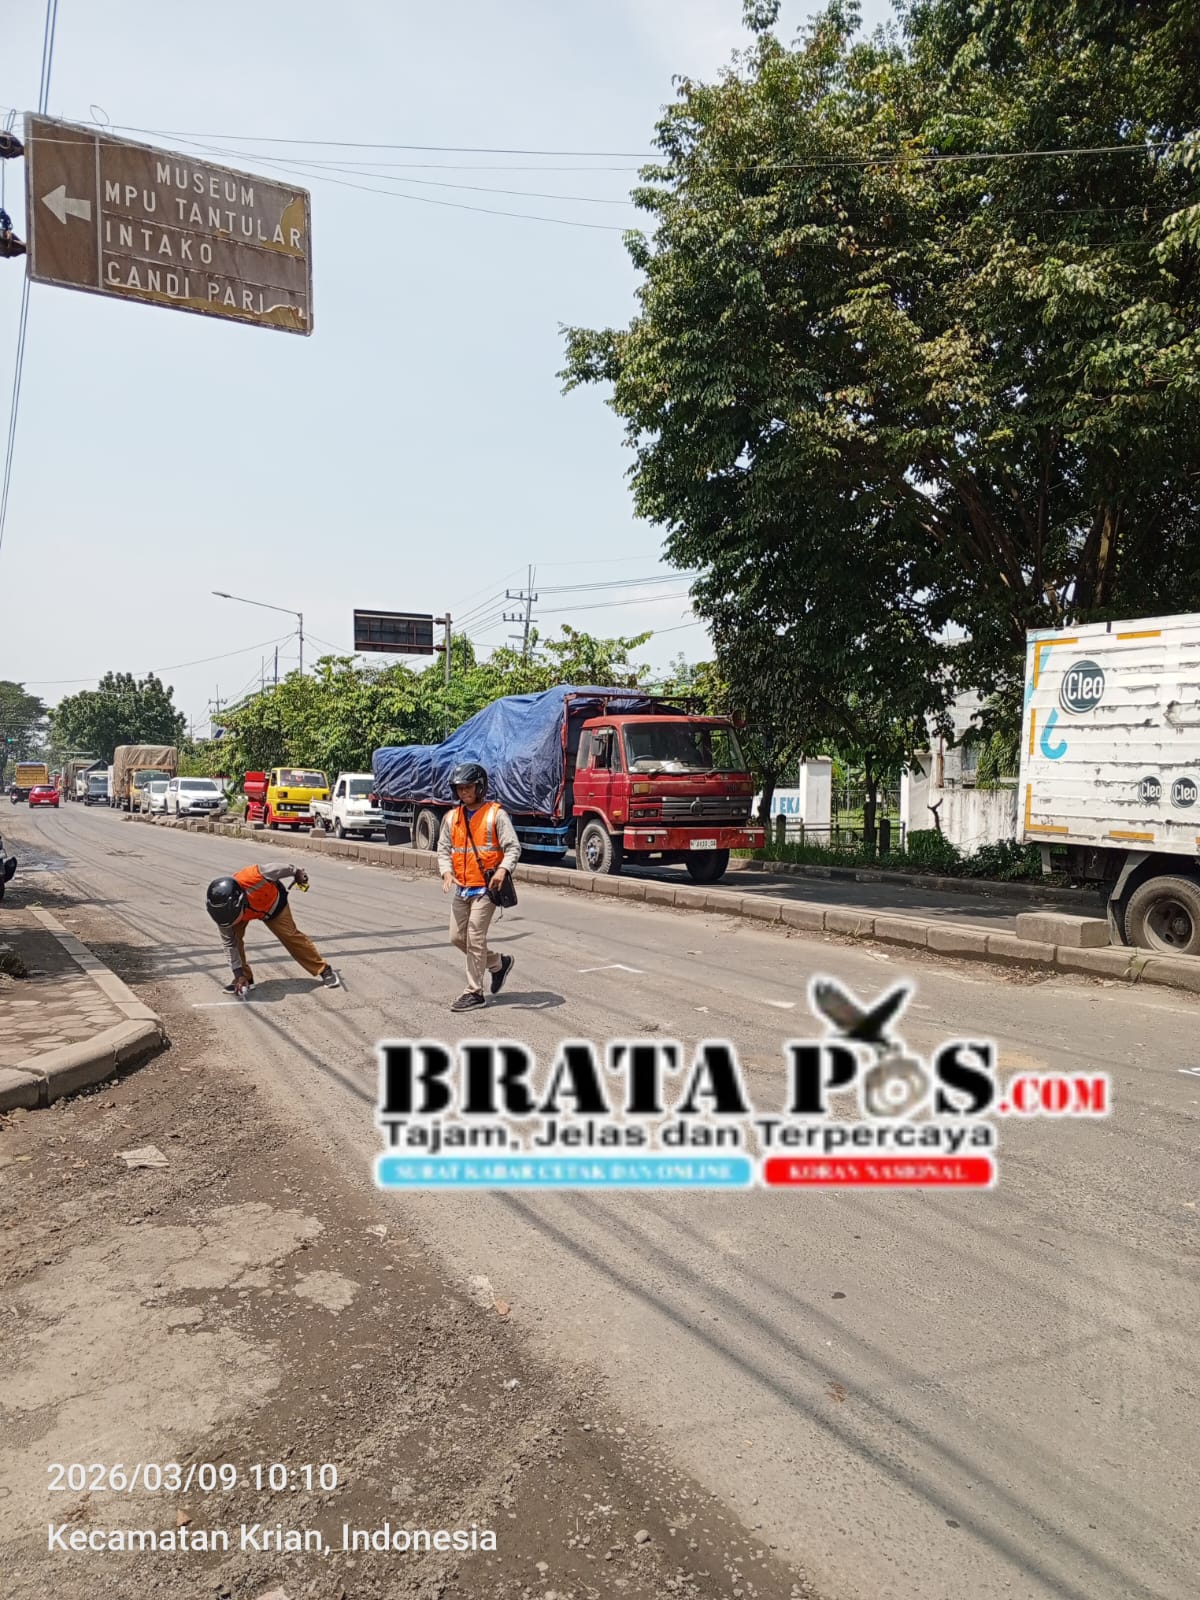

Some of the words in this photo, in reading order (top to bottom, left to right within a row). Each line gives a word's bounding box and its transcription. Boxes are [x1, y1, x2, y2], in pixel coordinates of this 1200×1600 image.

[156, 161, 255, 208] MUSEUM
[105, 180, 157, 213] MPU
[175, 198, 302, 249] TANTULAR
[106, 220, 213, 265] INTAKO
[107, 261, 190, 298] CANDI
[208, 283, 265, 313] PARI
[1068, 672, 1103, 700] Cleo
[1141, 781, 1161, 798] Cleo
[1174, 784, 1197, 801] Cleo
